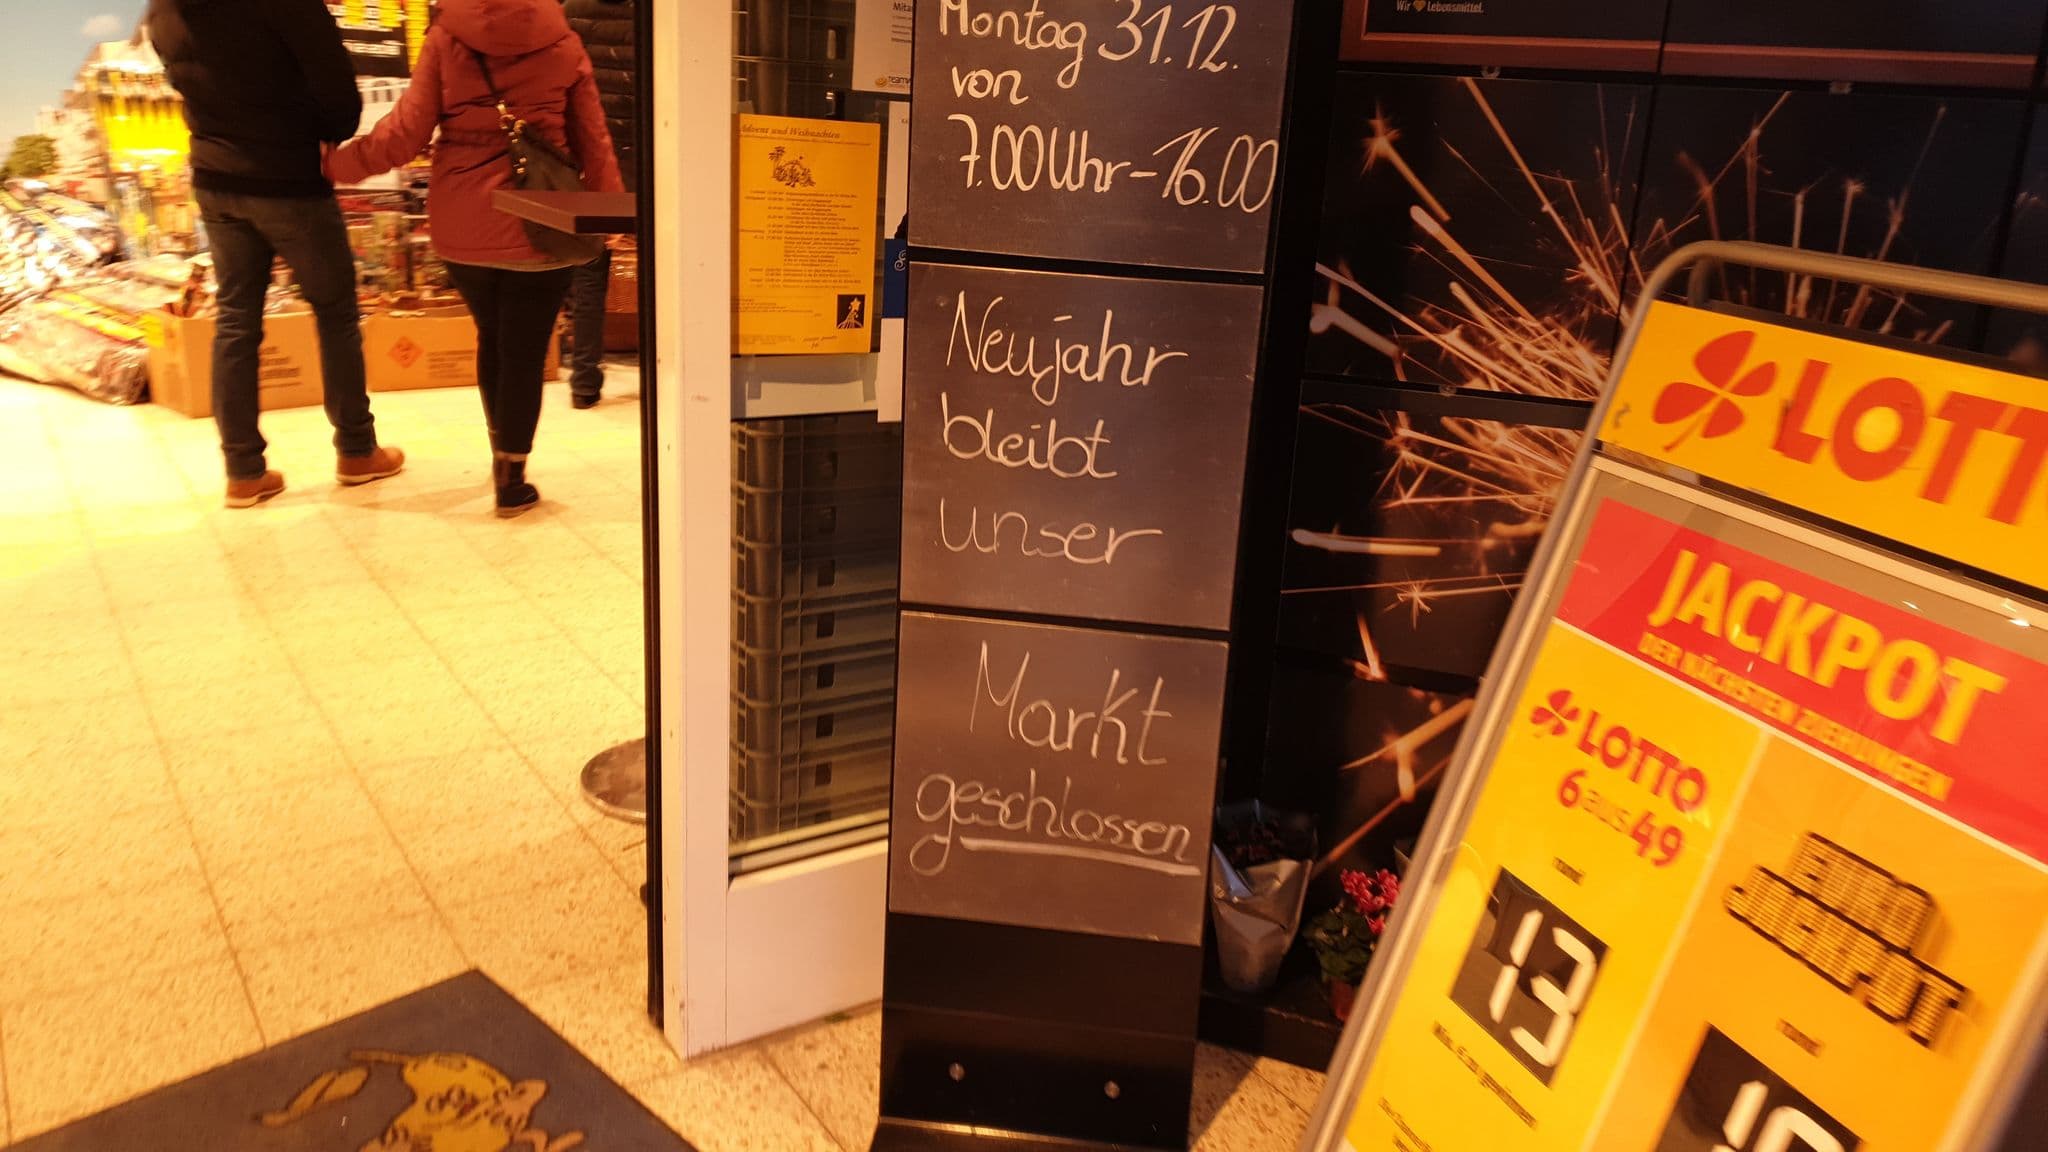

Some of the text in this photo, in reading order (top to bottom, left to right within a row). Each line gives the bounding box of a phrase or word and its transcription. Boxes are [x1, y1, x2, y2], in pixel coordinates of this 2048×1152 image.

[939, 0, 1087, 89] Montag
[951, 66, 1029, 105] von
[946, 290, 1189, 406] Neujahr
[941, 391, 1118, 478] bleibt
[1773, 357, 2048, 527] LOTT
[1636, 630, 1682, 671] DER
[1647, 548, 2010, 746] JACKPOT
[969, 639, 1174, 765] Markt
[1575, 709, 1709, 815] LOTTO
[909, 768, 1191, 876] geschlossen
[1488, 908, 1598, 1068] 13
